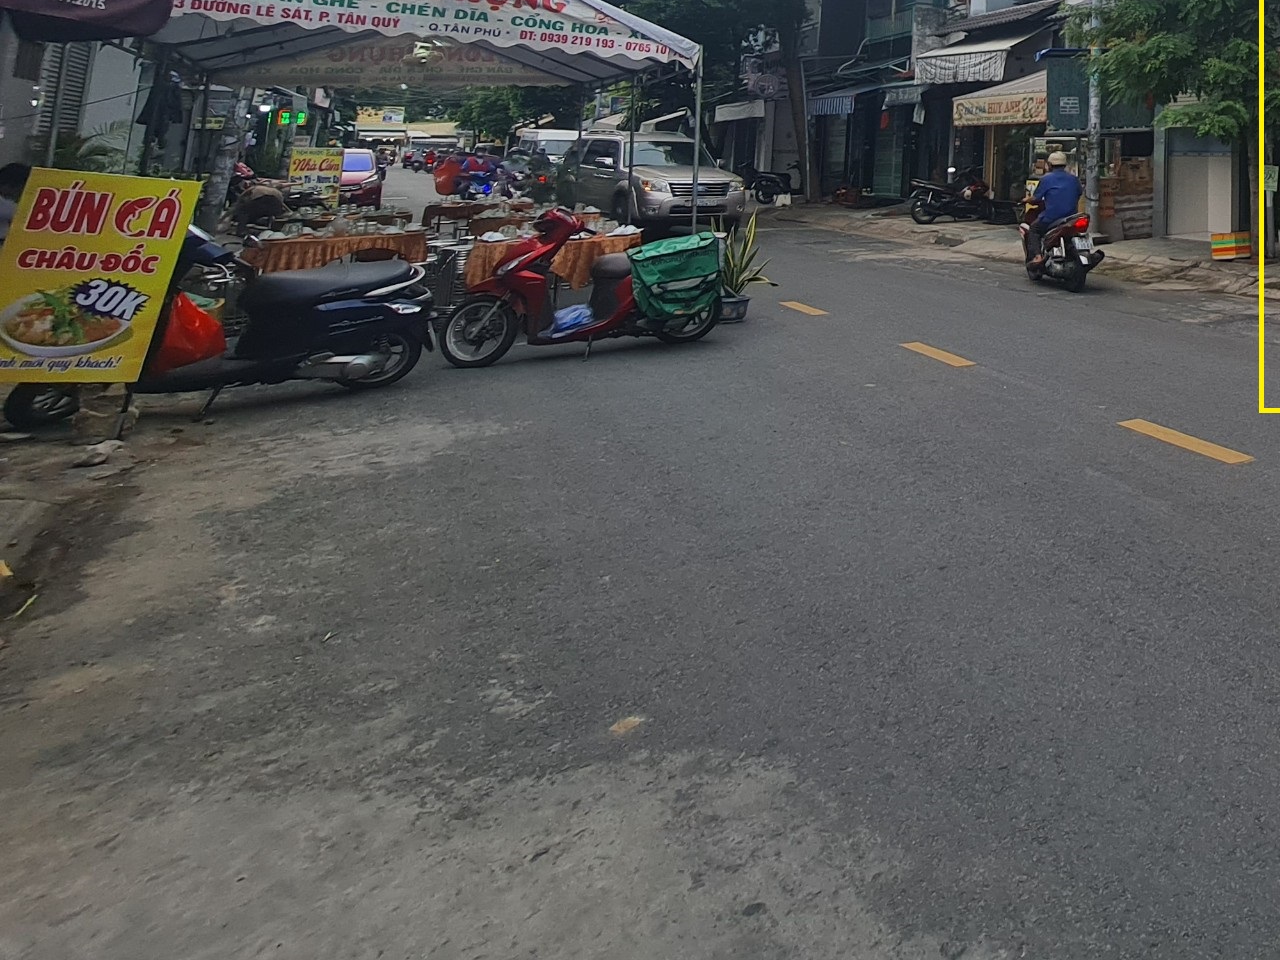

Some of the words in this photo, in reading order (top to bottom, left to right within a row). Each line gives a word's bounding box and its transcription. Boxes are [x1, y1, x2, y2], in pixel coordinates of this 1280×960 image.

[256, 2, 275, 18] LÊ
[280, 4, 314, 23] SÁT,
[318, 12, 331, 23] P.
[336, 11, 367, 26] TÂN
[428, 21, 471, 36] Q.TÂN
[473, 24, 502, 38] PHÚ
[519, 29, 537, 41] ĐT:
[539, 32, 568, 45] 0939
[570, 35, 592, 47] 219
[596, 38, 615, 49] 193
[625, 41, 651, 53] 0765
[454, 2, 490, 23] DĨA
[510, 11, 565, 32] CỔNG
[571, 22, 609, 37] HOA
[25, 180, 114, 237] BÚN
[115, 188, 182, 240] CÁ
[17, 245, 98, 270] CHÂU
[99, 243, 160, 274] ĐỐC
[75, 279, 150, 322] 30K
